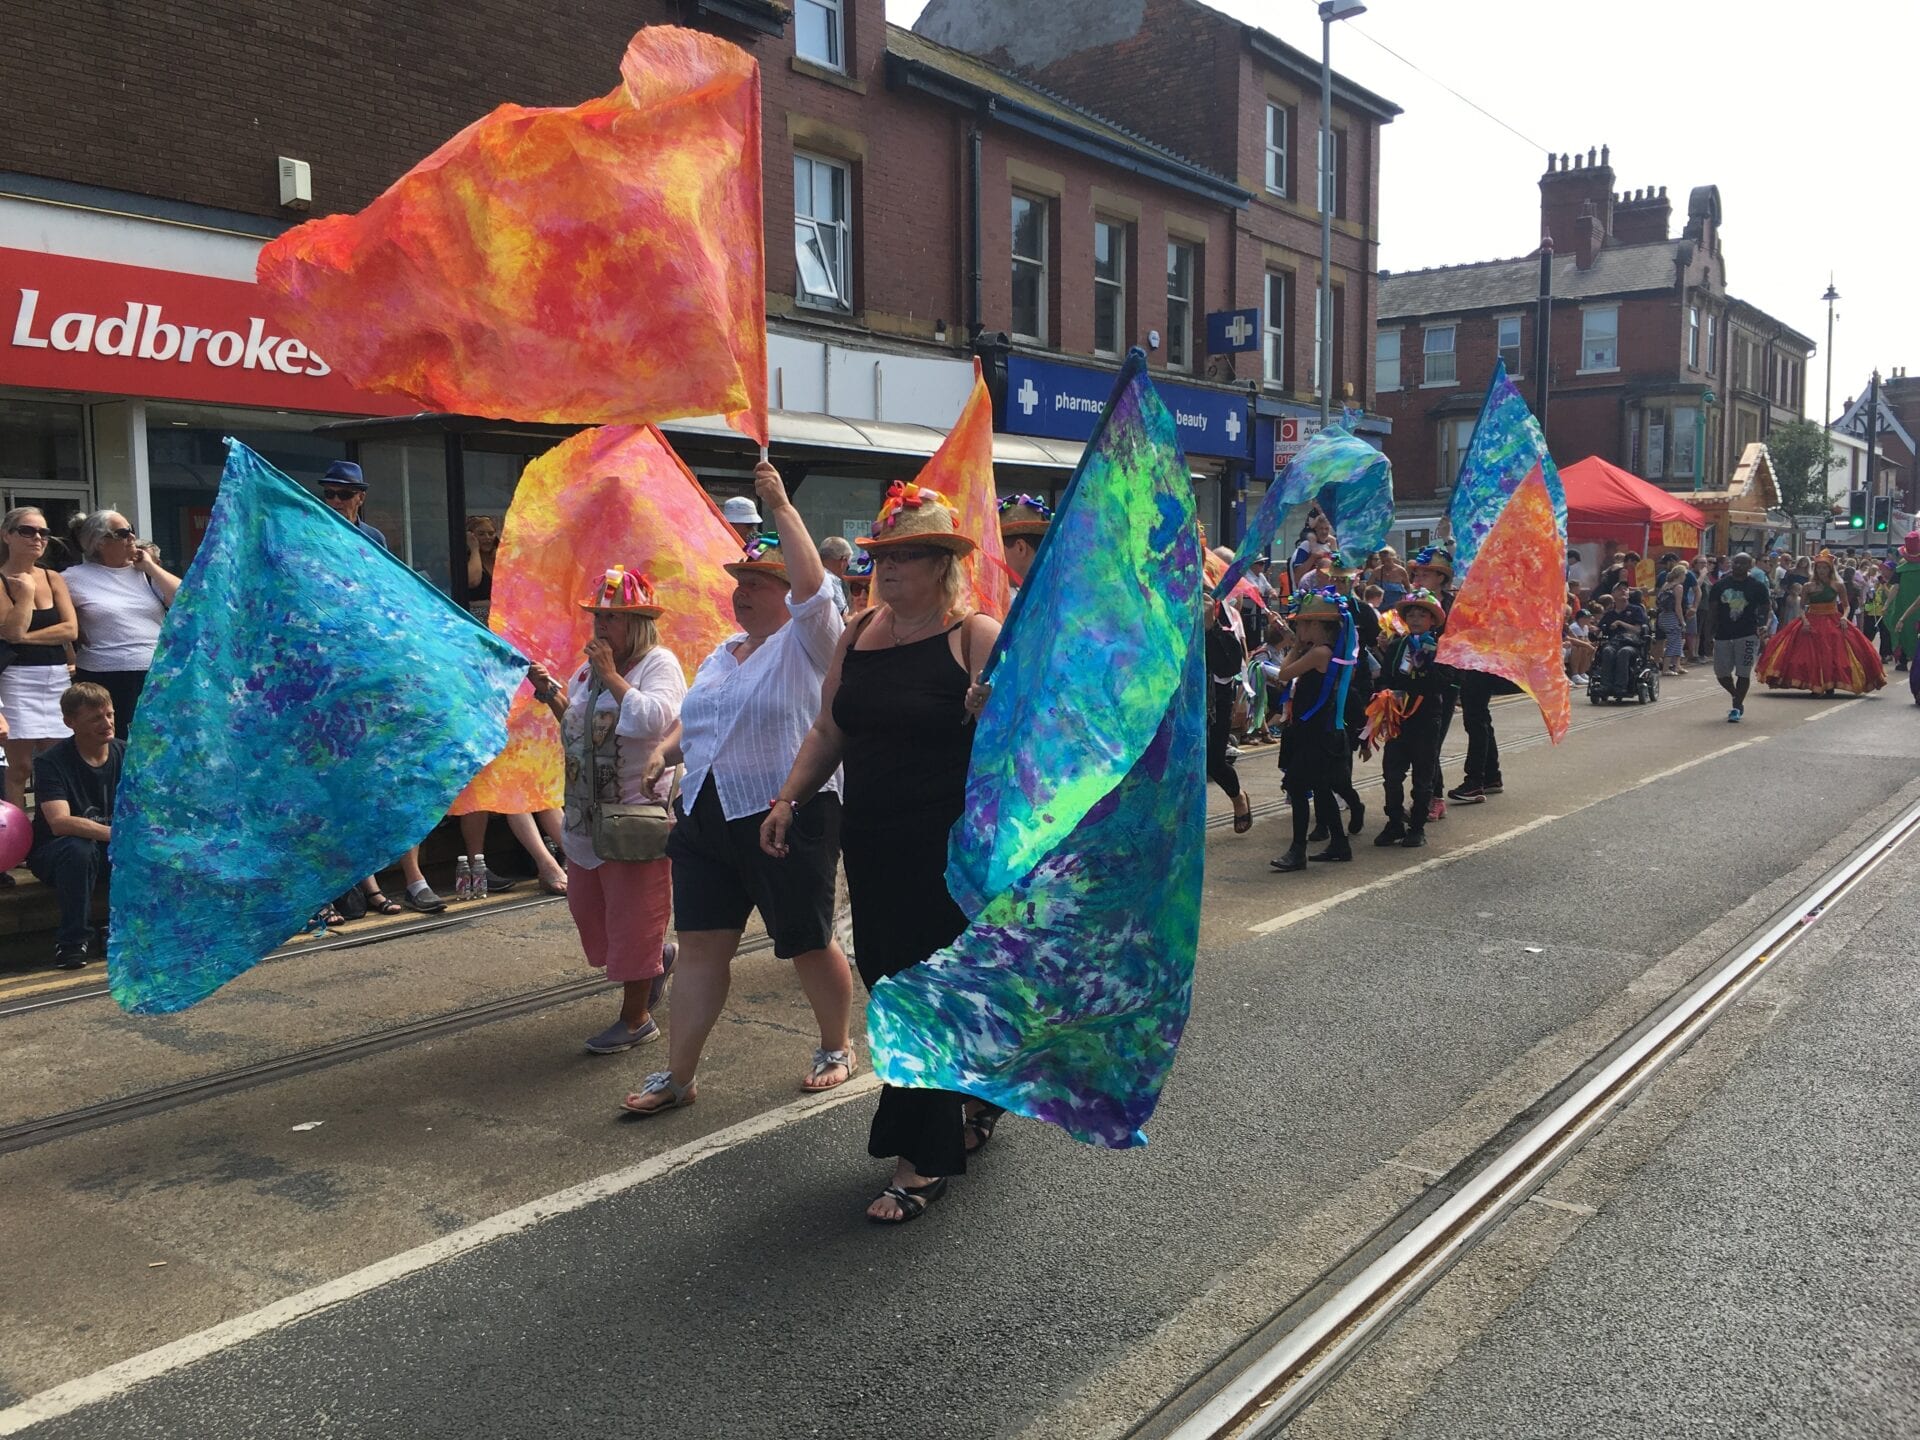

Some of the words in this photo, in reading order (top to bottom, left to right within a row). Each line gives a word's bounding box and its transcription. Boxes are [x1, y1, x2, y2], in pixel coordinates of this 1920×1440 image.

[12, 288, 332, 377] Ladbrokes
[1055, 391, 1107, 414] pharmac
[1176, 409, 1208, 431] beauty
[844, 521, 855, 529] TO
[856, 521, 870, 530] LET
[1744, 640, 1754, 667] BOSS
